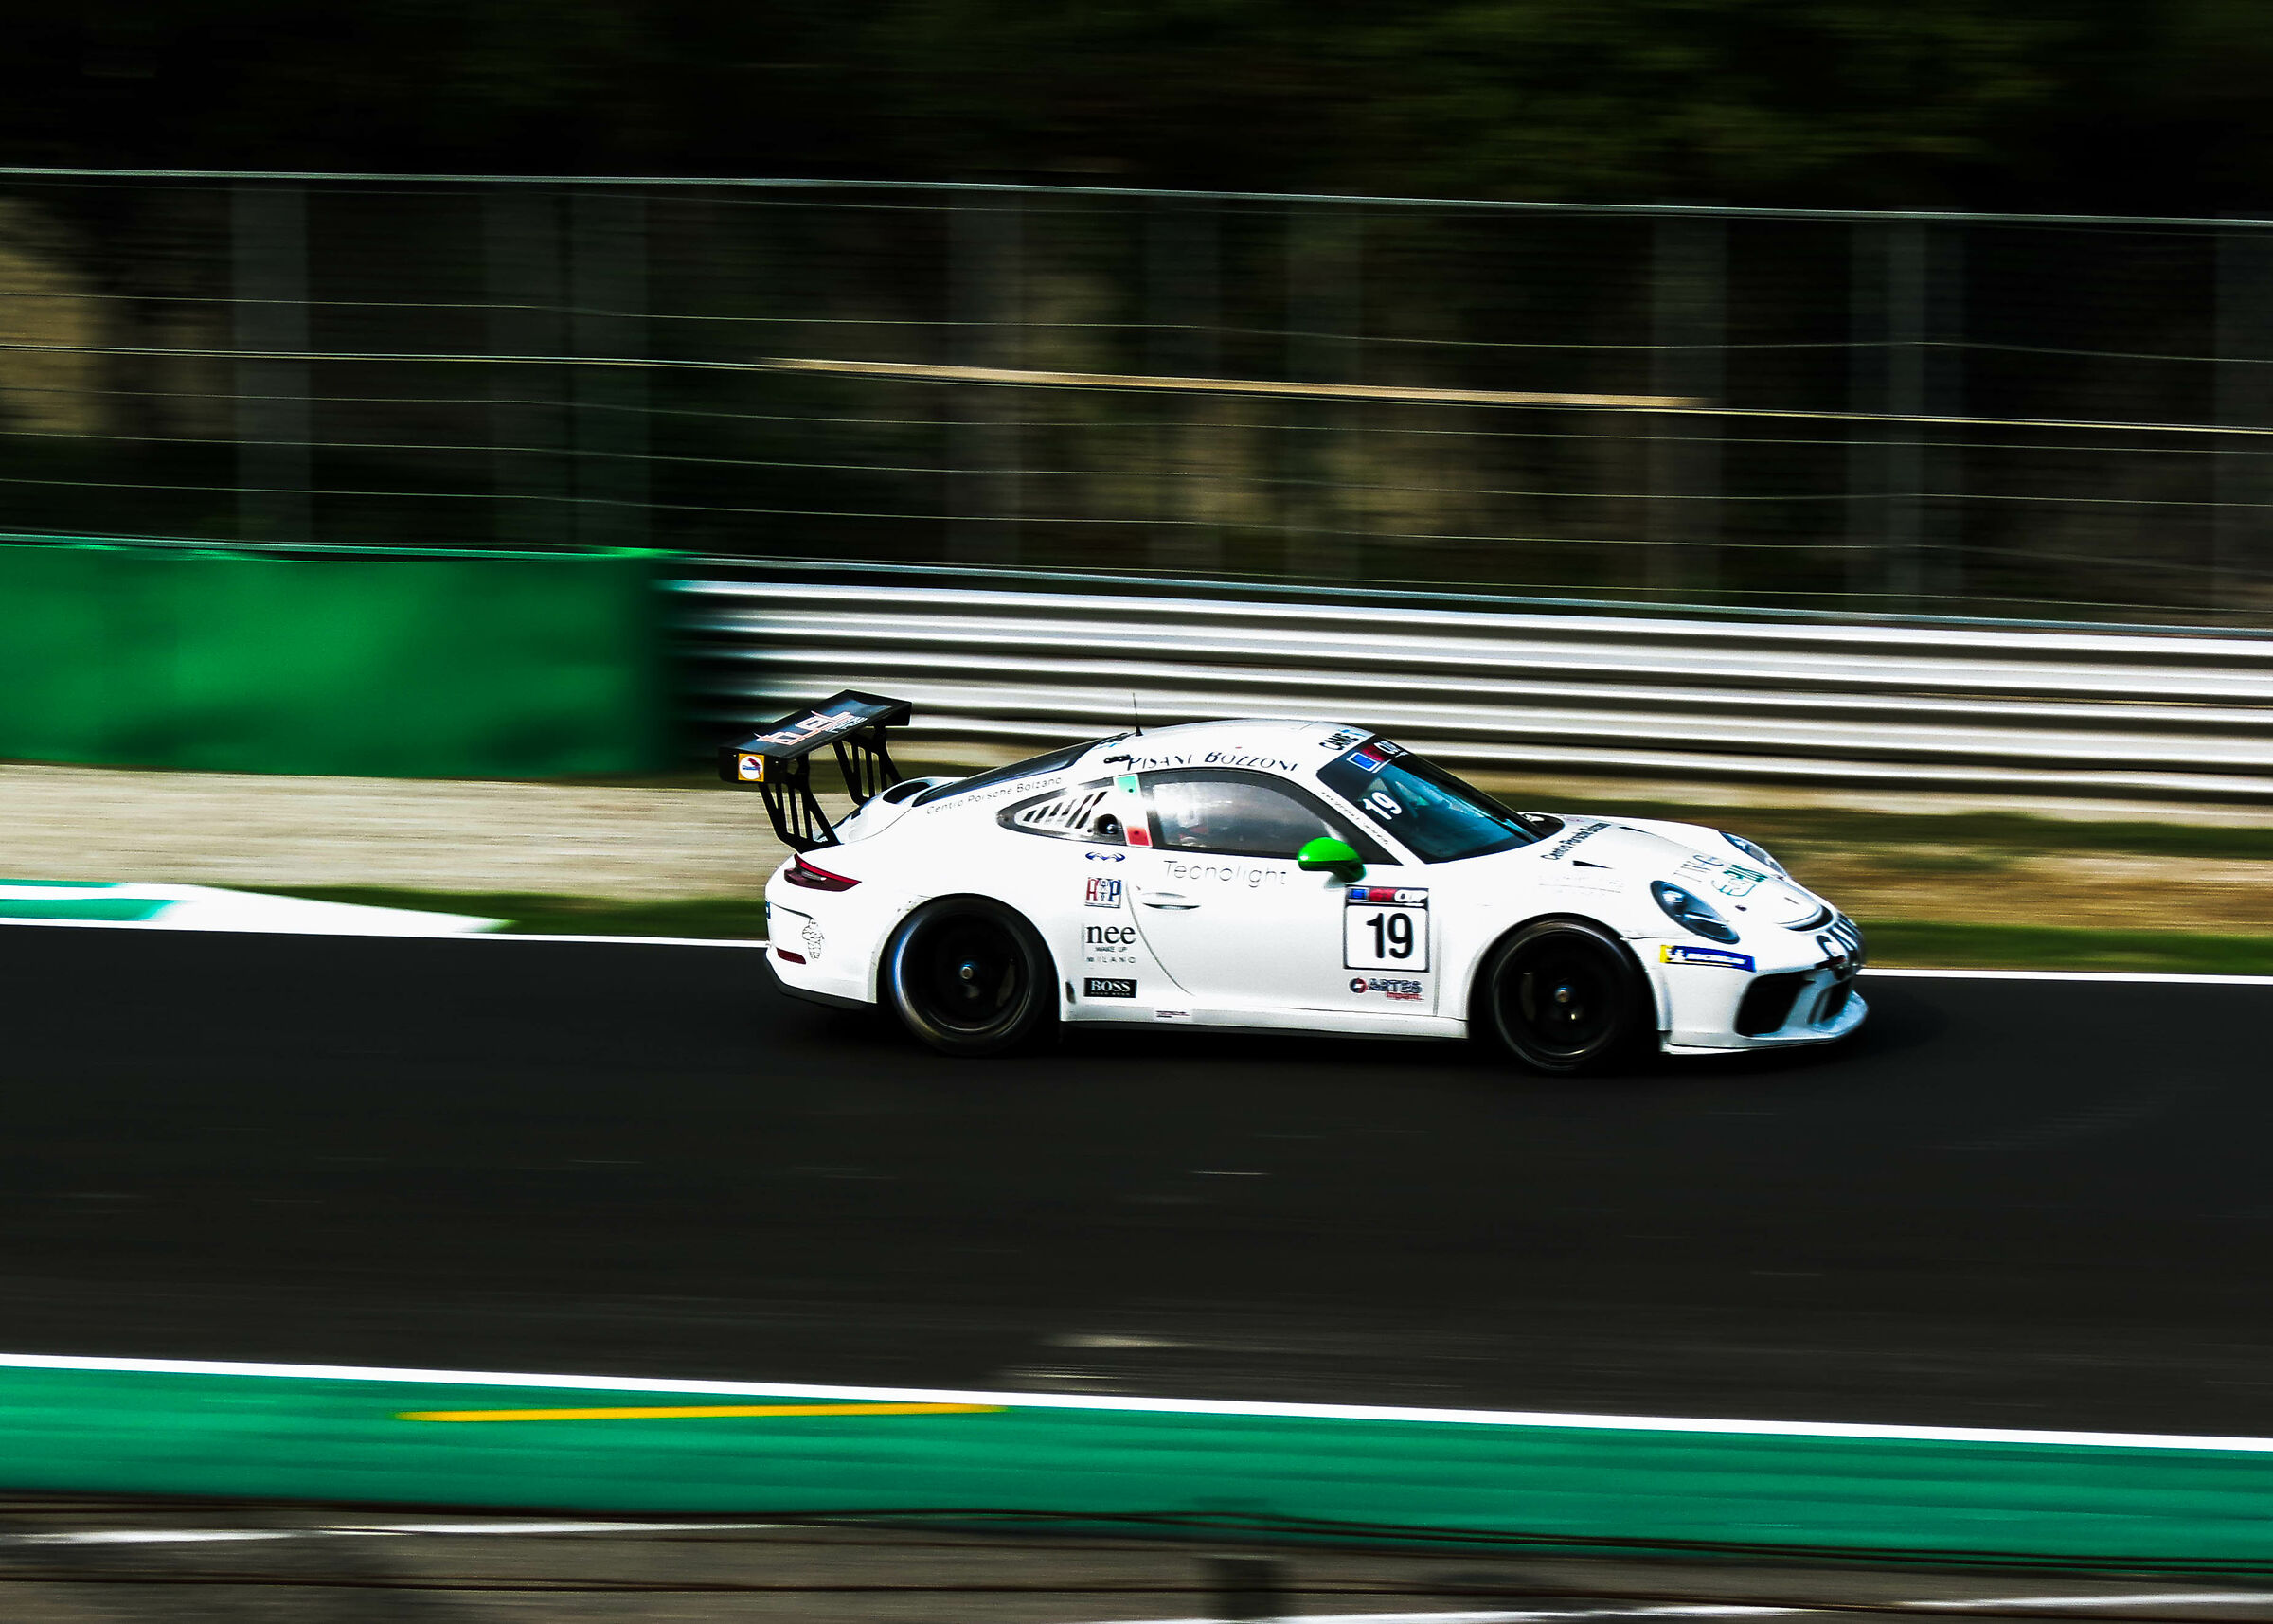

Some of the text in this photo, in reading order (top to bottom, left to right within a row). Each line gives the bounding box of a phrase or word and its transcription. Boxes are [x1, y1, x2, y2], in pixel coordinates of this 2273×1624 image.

[1204, 752, 1298, 772] BOZZONI
[926, 776, 1062, 815] Centro Porsche Bolzano
[1363, 792, 1402, 820] 19
[1163, 860, 1287, 888] Tecnolight
[1084, 925, 1137, 945] nee
[1366, 912, 1414, 960] 19
[1090, 980, 1131, 991] BOSS
